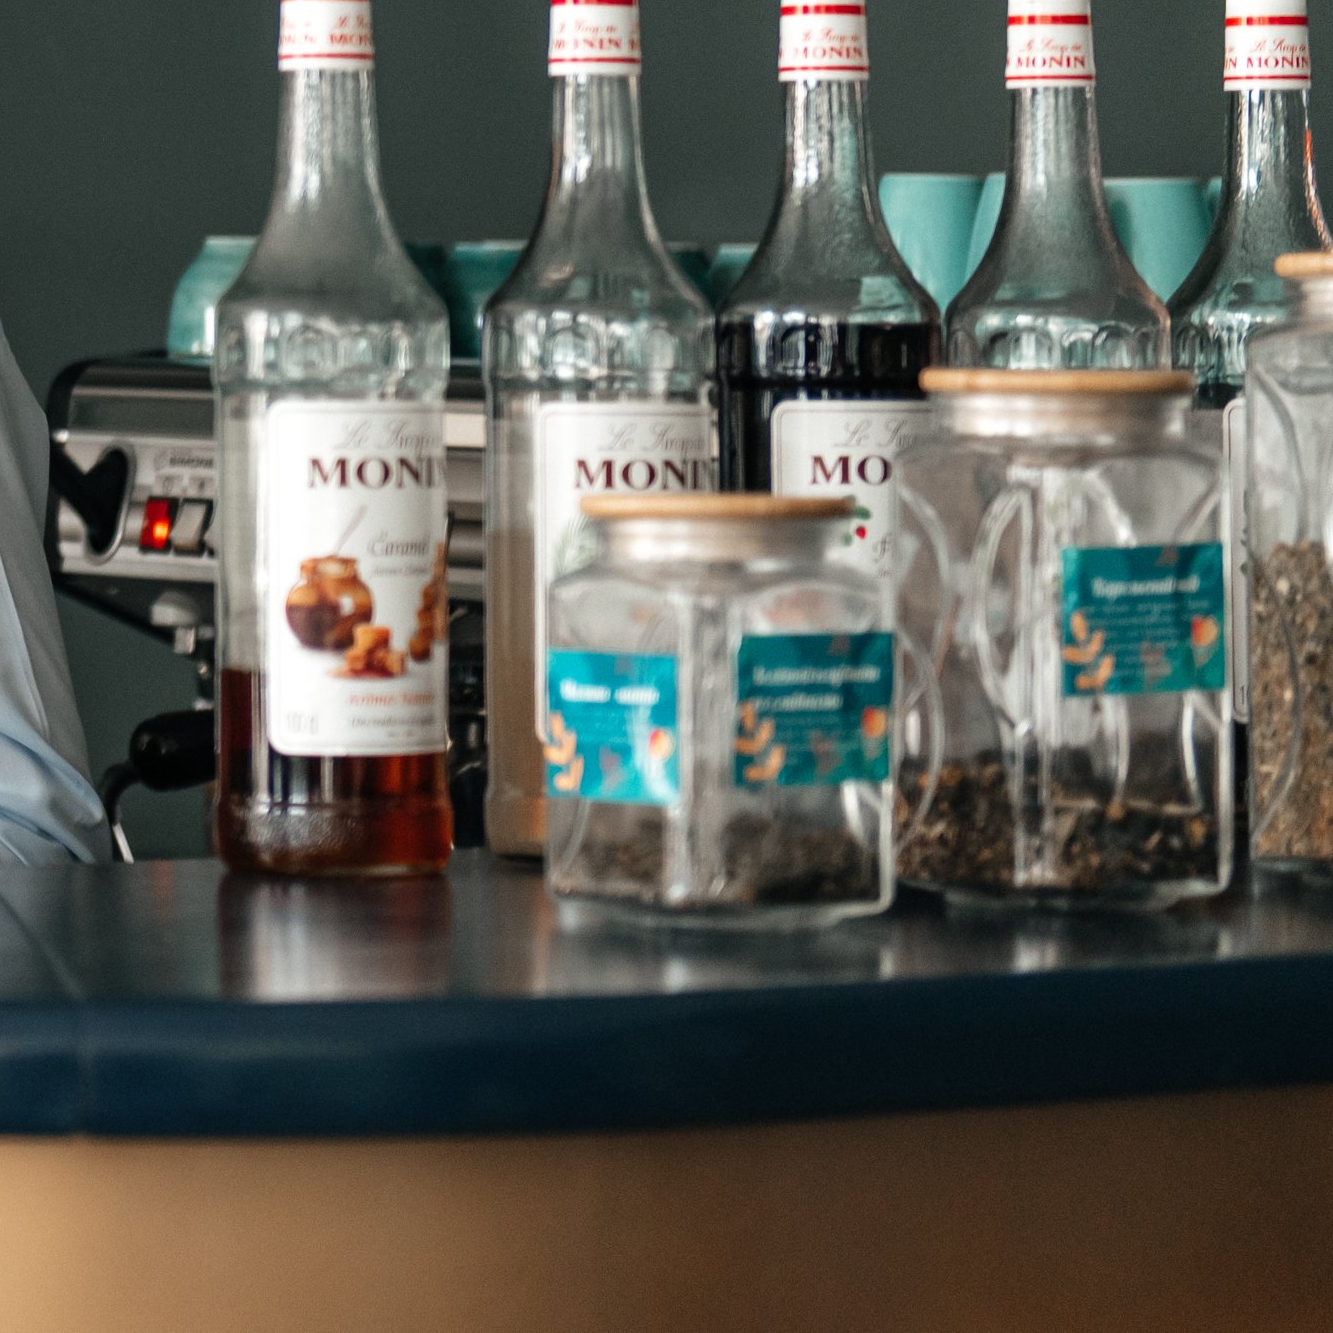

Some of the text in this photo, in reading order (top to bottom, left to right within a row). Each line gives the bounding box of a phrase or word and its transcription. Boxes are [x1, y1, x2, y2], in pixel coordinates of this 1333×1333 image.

[793, 46, 863, 60] MONIN
[1016, 55, 1086, 69] MONIN
[1246, 56, 1309, 70] MONIN
[308, 456, 437, 489] MONI
